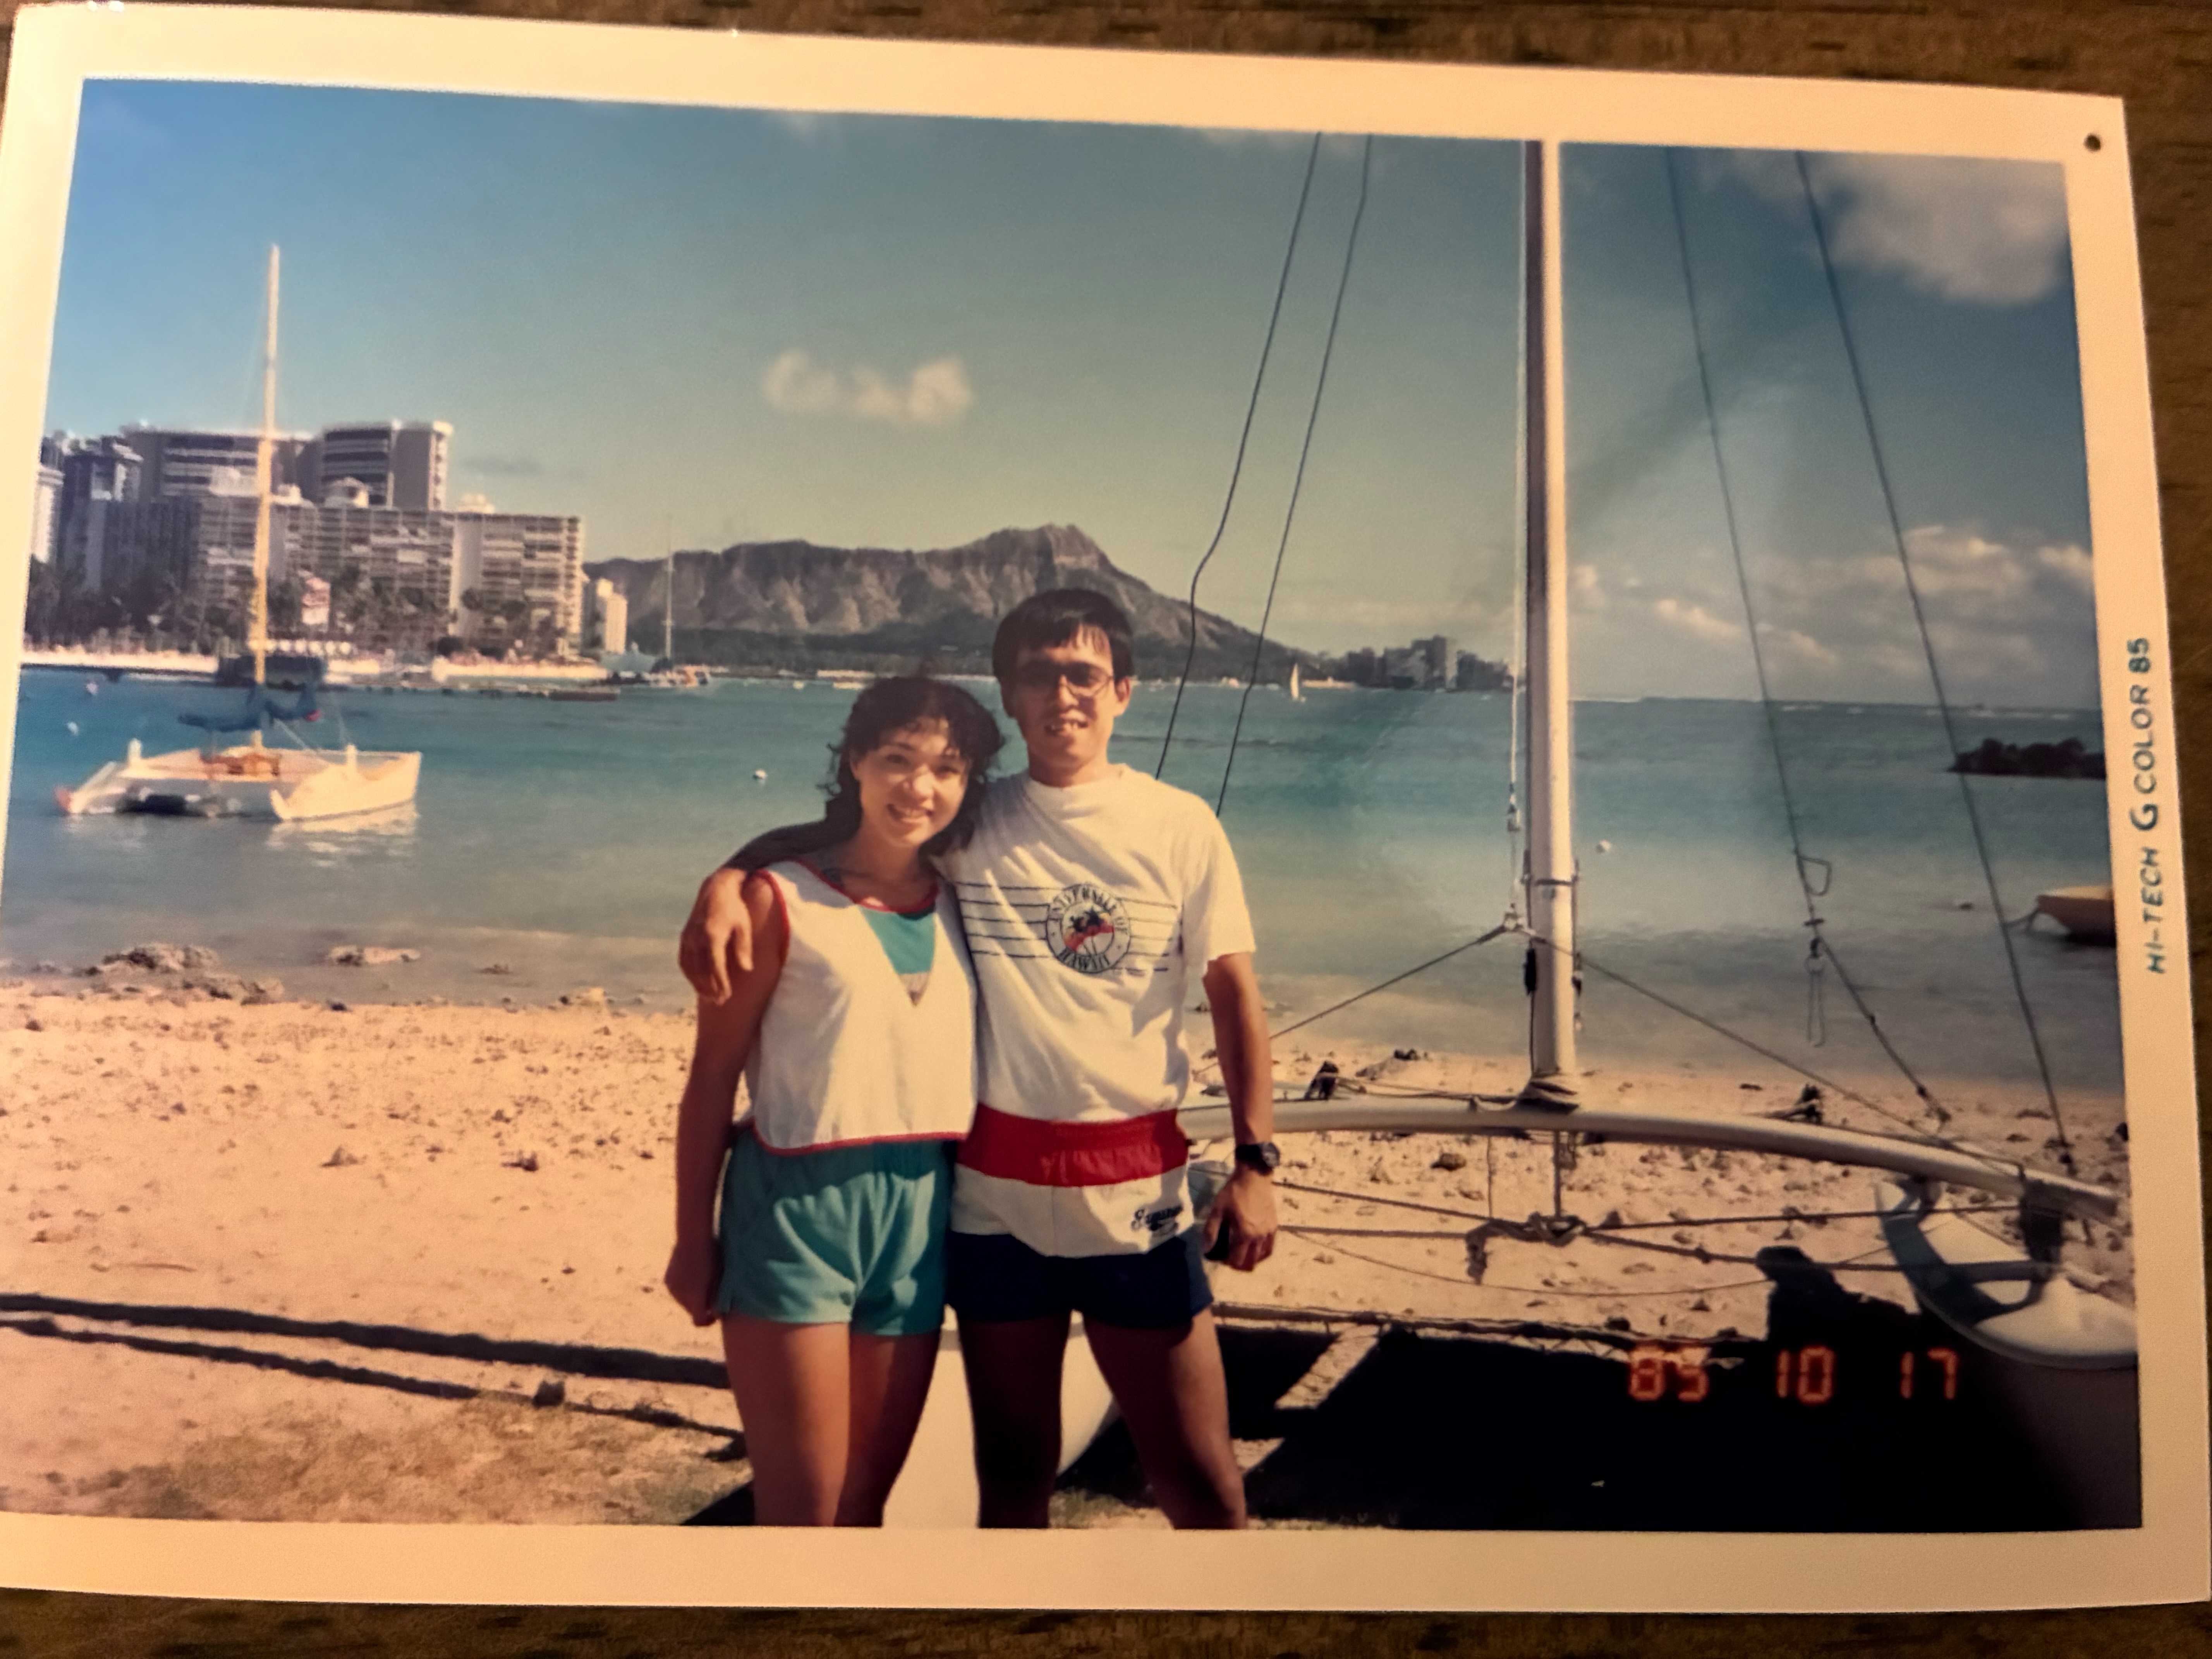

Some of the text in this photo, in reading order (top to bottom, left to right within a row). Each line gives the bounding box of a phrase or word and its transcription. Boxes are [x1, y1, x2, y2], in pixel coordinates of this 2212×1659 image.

[2127, 637, 2165, 974] HI-TECH G COLOR 85
[1057, 948, 1111, 970] HAWAII
